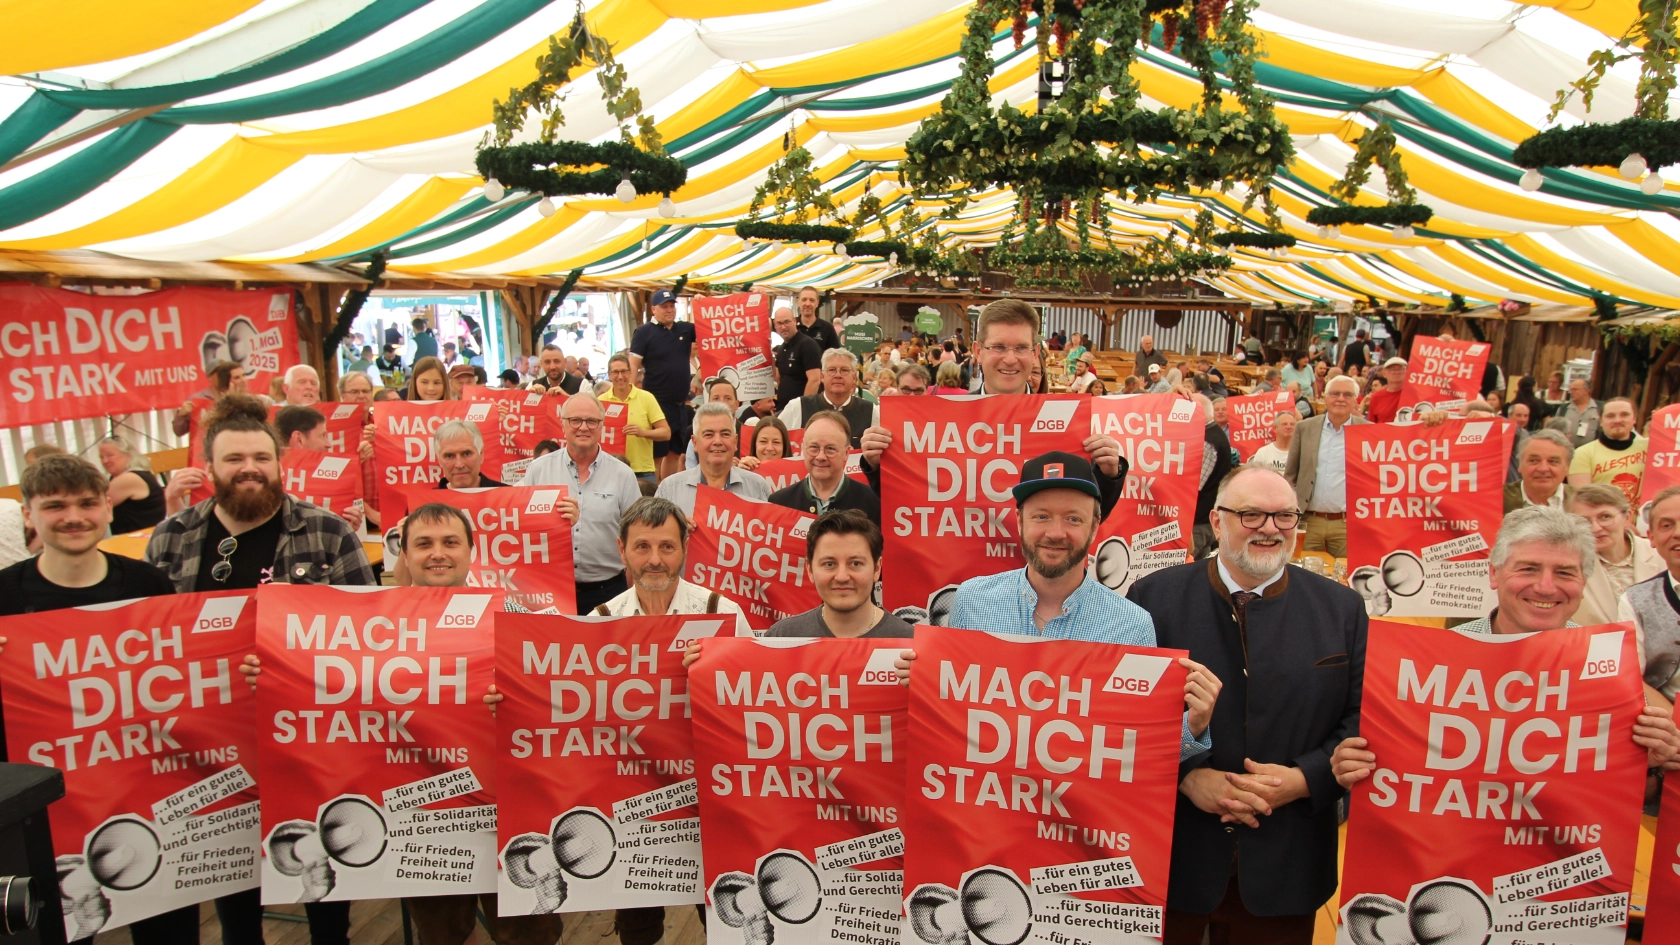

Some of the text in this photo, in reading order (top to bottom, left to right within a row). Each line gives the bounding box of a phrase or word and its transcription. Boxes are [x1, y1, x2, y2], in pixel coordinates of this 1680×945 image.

[701, 304, 745, 319] MACH
[64, 306, 183, 354] DICH
[711, 316, 760, 337] DICH
[259, 335, 279, 350] Mai
[701, 335, 745, 351] STARK
[736, 347, 747, 355] MIT
[1419, 344, 1463, 361] MACH
[249, 354, 277, 369] 2025
[1423, 357, 1474, 379] DICH
[9, 362, 127, 403] STARK
[135, 365, 198, 387] MIT UNS
[1408, 372, 1453, 389] STARK
[1171, 411, 1190, 422] DGB
[1234, 401, 1273, 414] MACH
[903, 419, 1065, 455] MACH DGB
[1233, 427, 1273, 442] STARK
[1460, 433, 1482, 443] DGB
[1362, 439, 1449, 462] MACH
[317, 469, 338, 478] DGB
[927, 458, 1025, 502] DIC
[1379, 462, 1478, 495] DICH
[530, 504, 551, 512] DGB
[1137, 504, 1179, 517] MIT UNS
[1355, 496, 1443, 519] STARK
[707, 505, 784, 548] MACH
[893, 506, 1012, 538] STARK
[1423, 519, 1479, 531] MIT UNS
[986, 543, 1017, 558] MIT
[1133, 531, 1178, 552] Leben für alle!
[1444, 535, 1481, 550] ein gutes
[717, 535, 807, 587] DICH
[1425, 542, 1483, 563] Leben für alle!
[692, 562, 772, 604] STARK
[1450, 584, 1484, 595] Frieden,
[1430, 599, 1482, 611] Demokratie!
[1433, 590, 1465, 600] Freiheit
[444, 615, 475, 626] DGB
[750, 602, 772, 618] MIT
[200, 617, 233, 630] DGB
[286, 613, 427, 651] MACH
[33, 625, 183, 680] MACH
[522, 640, 658, 676] MACH
[865, 670, 897, 683] DGB
[1587, 659, 1617, 676] DGB
[314, 655, 468, 705] DICH
[715, 670, 849, 709] MACH
[939, 660, 1092, 717] MACH
[1112, 676, 1149, 692] DGB
[1397, 658, 1570, 713] MACH
[68, 658, 232, 729] DICH
[549, 678, 692, 723] DICH
[272, 709, 416, 744] STARK
[743, 711, 893, 763] DICH
[28, 716, 182, 771] STARK
[510, 724, 646, 759] STARK
[966, 708, 1137, 784] DICH
[1425, 711, 1611, 775] DICH
[152, 745, 239, 775] MIT UNS
[386, 747, 469, 764] MIT UNS
[616, 759, 695, 776] MIT UNS
[155, 767, 243, 815] ...für ein gutes
[385, 770, 472, 802] ...für ein gutes
[711, 763, 845, 800] STARK
[921, 763, 1073, 819] STARK
[160, 777, 248, 826] Leben für alle!
[388, 781, 475, 813] Leben für alle!
[614, 781, 697, 814] ...für ein gutes
[1369, 767, 1547, 821] STARK
[399, 806, 497, 824] ...für Solidarität
[618, 807, 654, 825] Leben
[655, 802, 672, 813] für
[817, 804, 898, 823] MIT UNS
[389, 819, 497, 838] und Gerechtigkeit
[1037, 820, 1131, 852] MIT UNS
[1504, 824, 1602, 845] MIT UNS
[166, 846, 255, 865] ...für Frieden,
[391, 842, 475, 859] ...für Frieden,
[178, 856, 254, 876] Freiheit und
[400, 856, 474, 870] Freiheit und
[620, 854, 700, 869] ...für Frieden,
[1032, 861, 1132, 881] ...für ein gutes
[1494, 852, 1602, 890] ...für ein gutes
[175, 869, 253, 890] Demokratie!
[396, 868, 472, 883] Demokratie!
[628, 867, 698, 880] Freiheit und
[1036, 873, 1135, 895] Leben für alle!
[624, 880, 696, 893] Demokratie!
[1498, 865, 1604, 904] Leben für alle!
[1046, 900, 1160, 920] ...für Solidarität
[1508, 895, 1626, 918] ...für Solidarität
[1035, 913, 1160, 934] und Gerechtigkeit
[1494, 910, 1626, 933] und Gerechtigkeit
